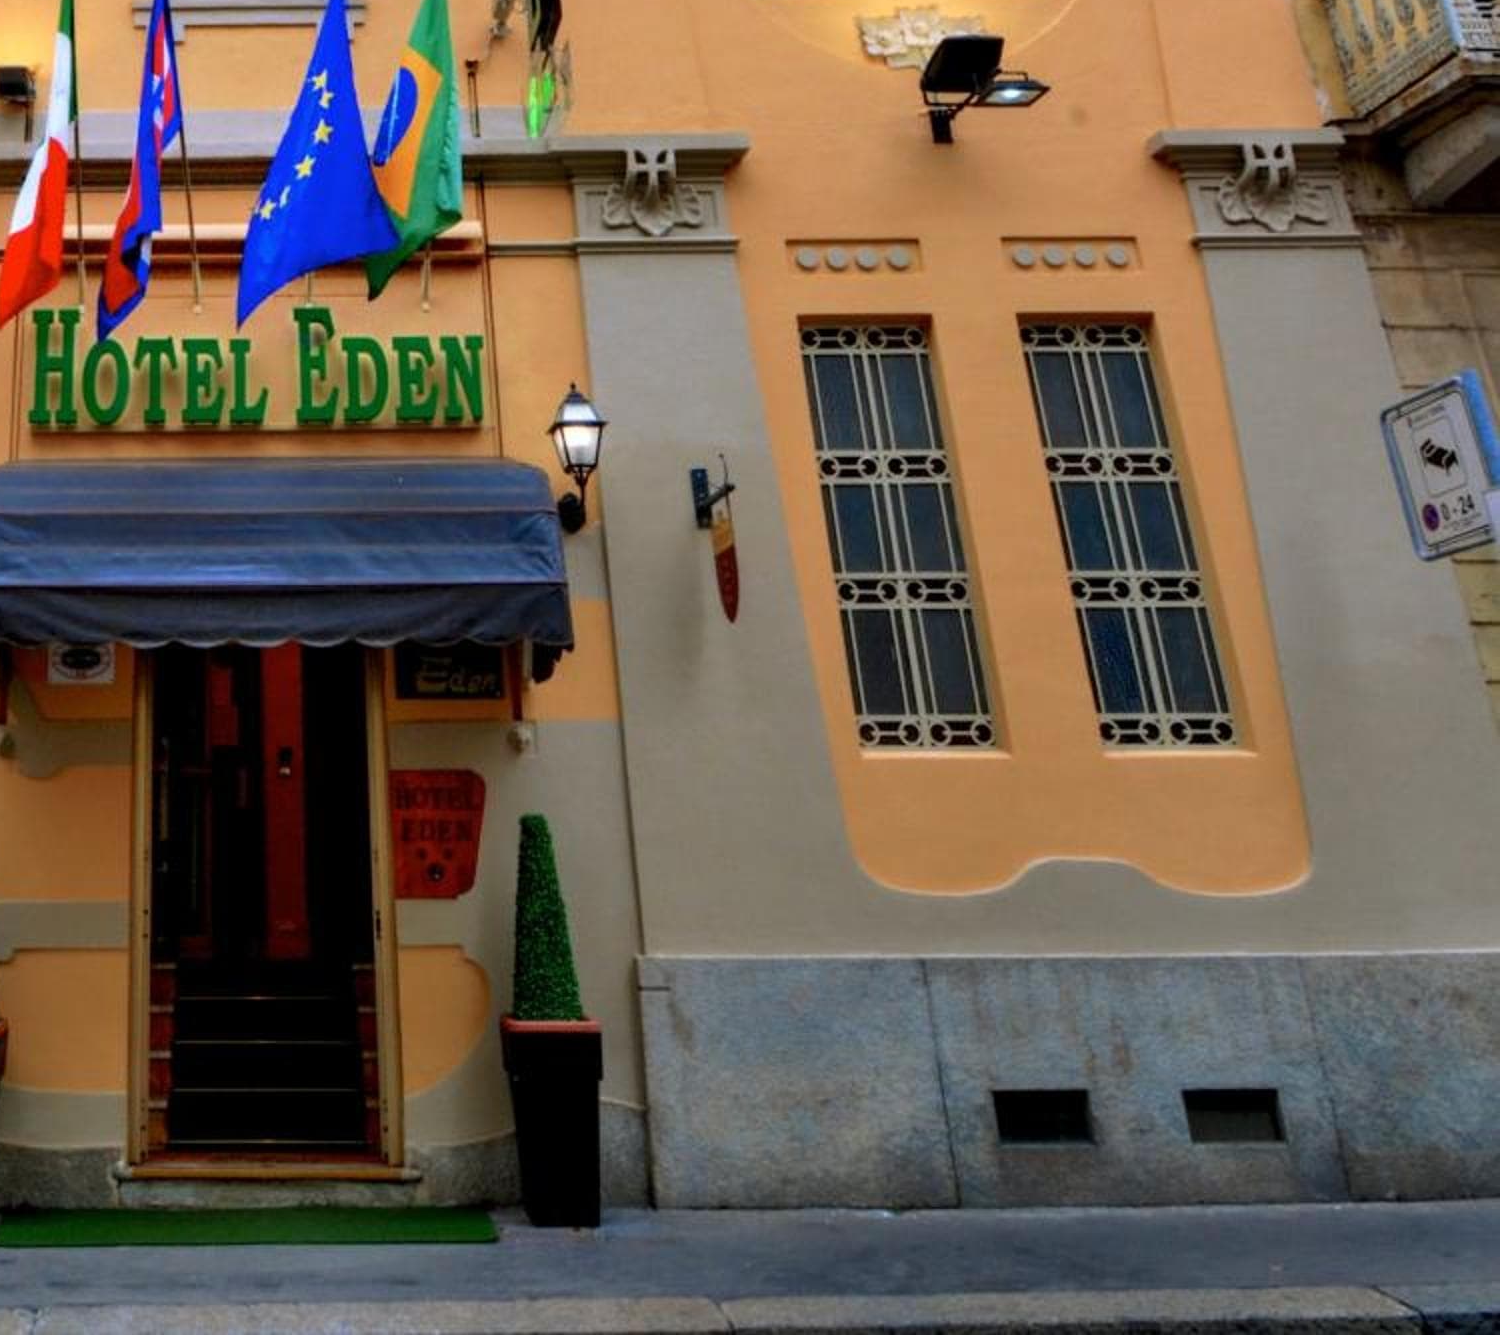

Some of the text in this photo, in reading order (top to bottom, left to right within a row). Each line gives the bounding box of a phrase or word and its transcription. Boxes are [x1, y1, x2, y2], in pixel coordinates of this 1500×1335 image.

[28, 306, 484, 427] HOTEL EDEN
[395, 785, 477, 810] HOTEL
[400, 819, 473, 842] EDEN
